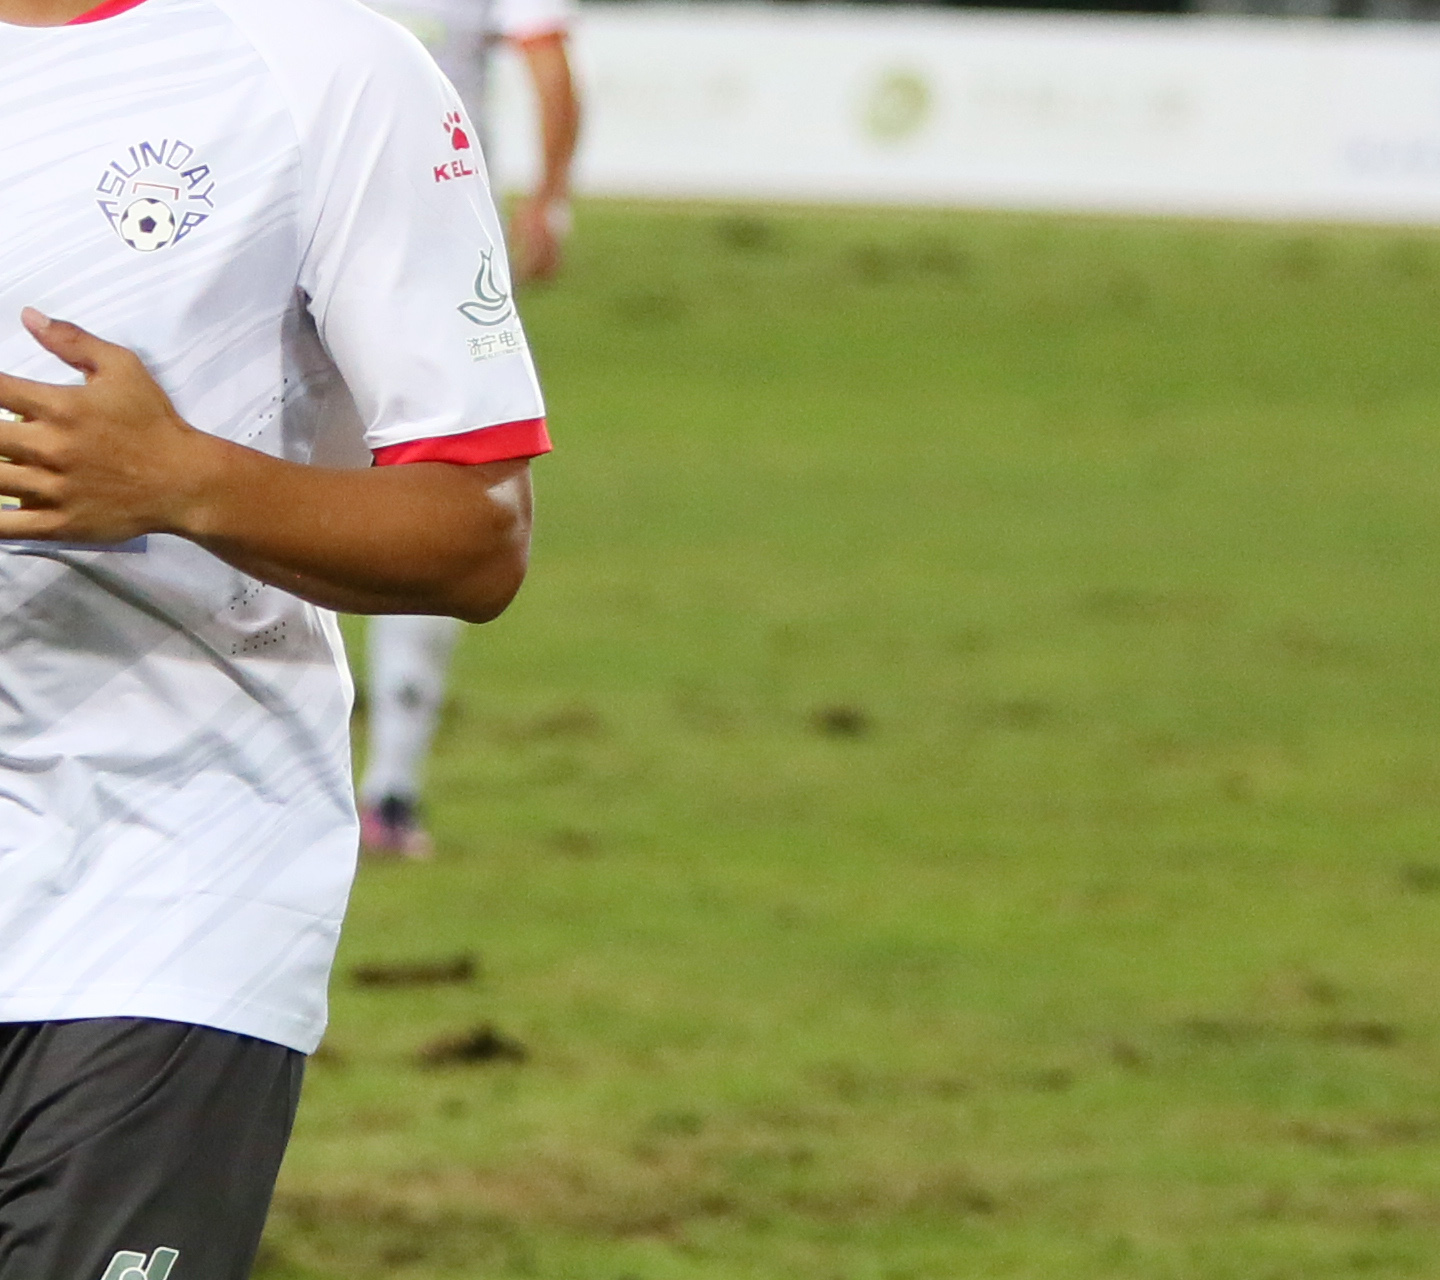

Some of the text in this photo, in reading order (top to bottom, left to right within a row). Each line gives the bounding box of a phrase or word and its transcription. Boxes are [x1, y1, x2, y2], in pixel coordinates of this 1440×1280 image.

[433, 159, 479, 183] KEL
[466, 329, 522, 356] 济宁电
